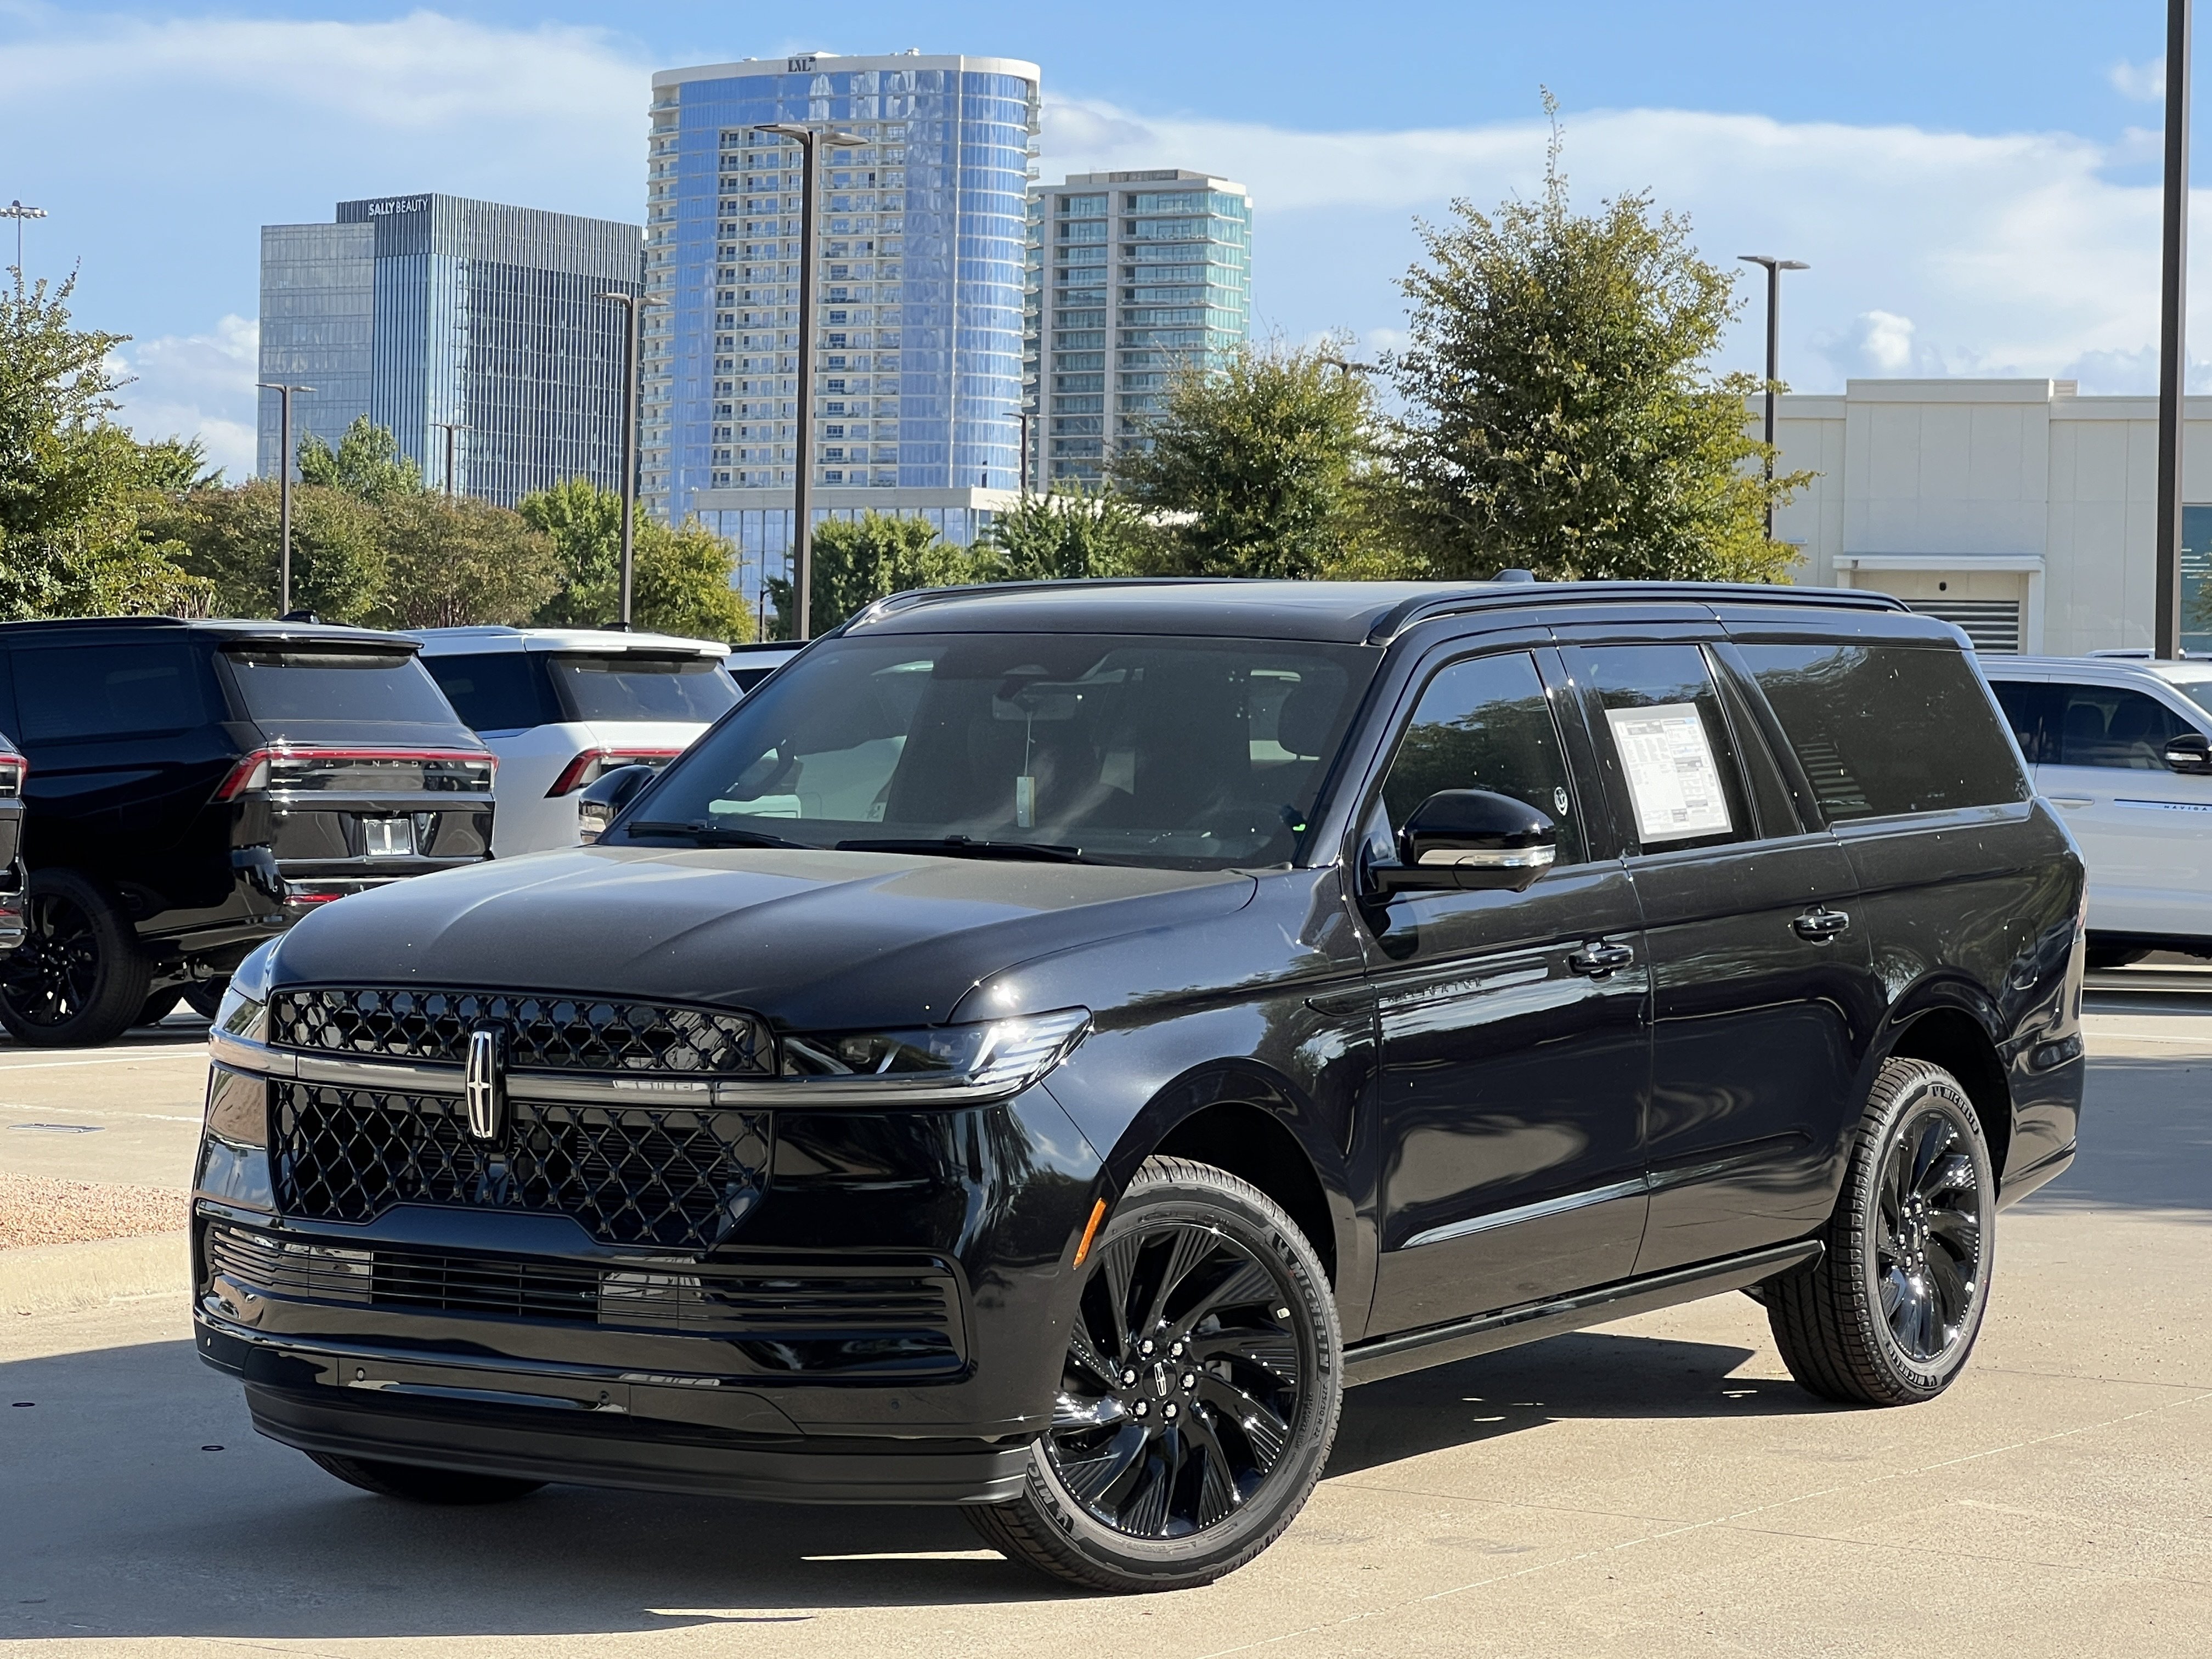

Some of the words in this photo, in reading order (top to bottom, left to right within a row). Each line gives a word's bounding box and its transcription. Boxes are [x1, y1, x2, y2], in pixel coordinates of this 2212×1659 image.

[369, 202, 394, 215] SALLY
[396, 199, 428, 213] BEAUTY
[1943, 1088, 1978, 1131] MICHELIN
[1290, 1262, 1329, 1367] MICHELIN
[1888, 1344, 1925, 1385] MICHELIN
